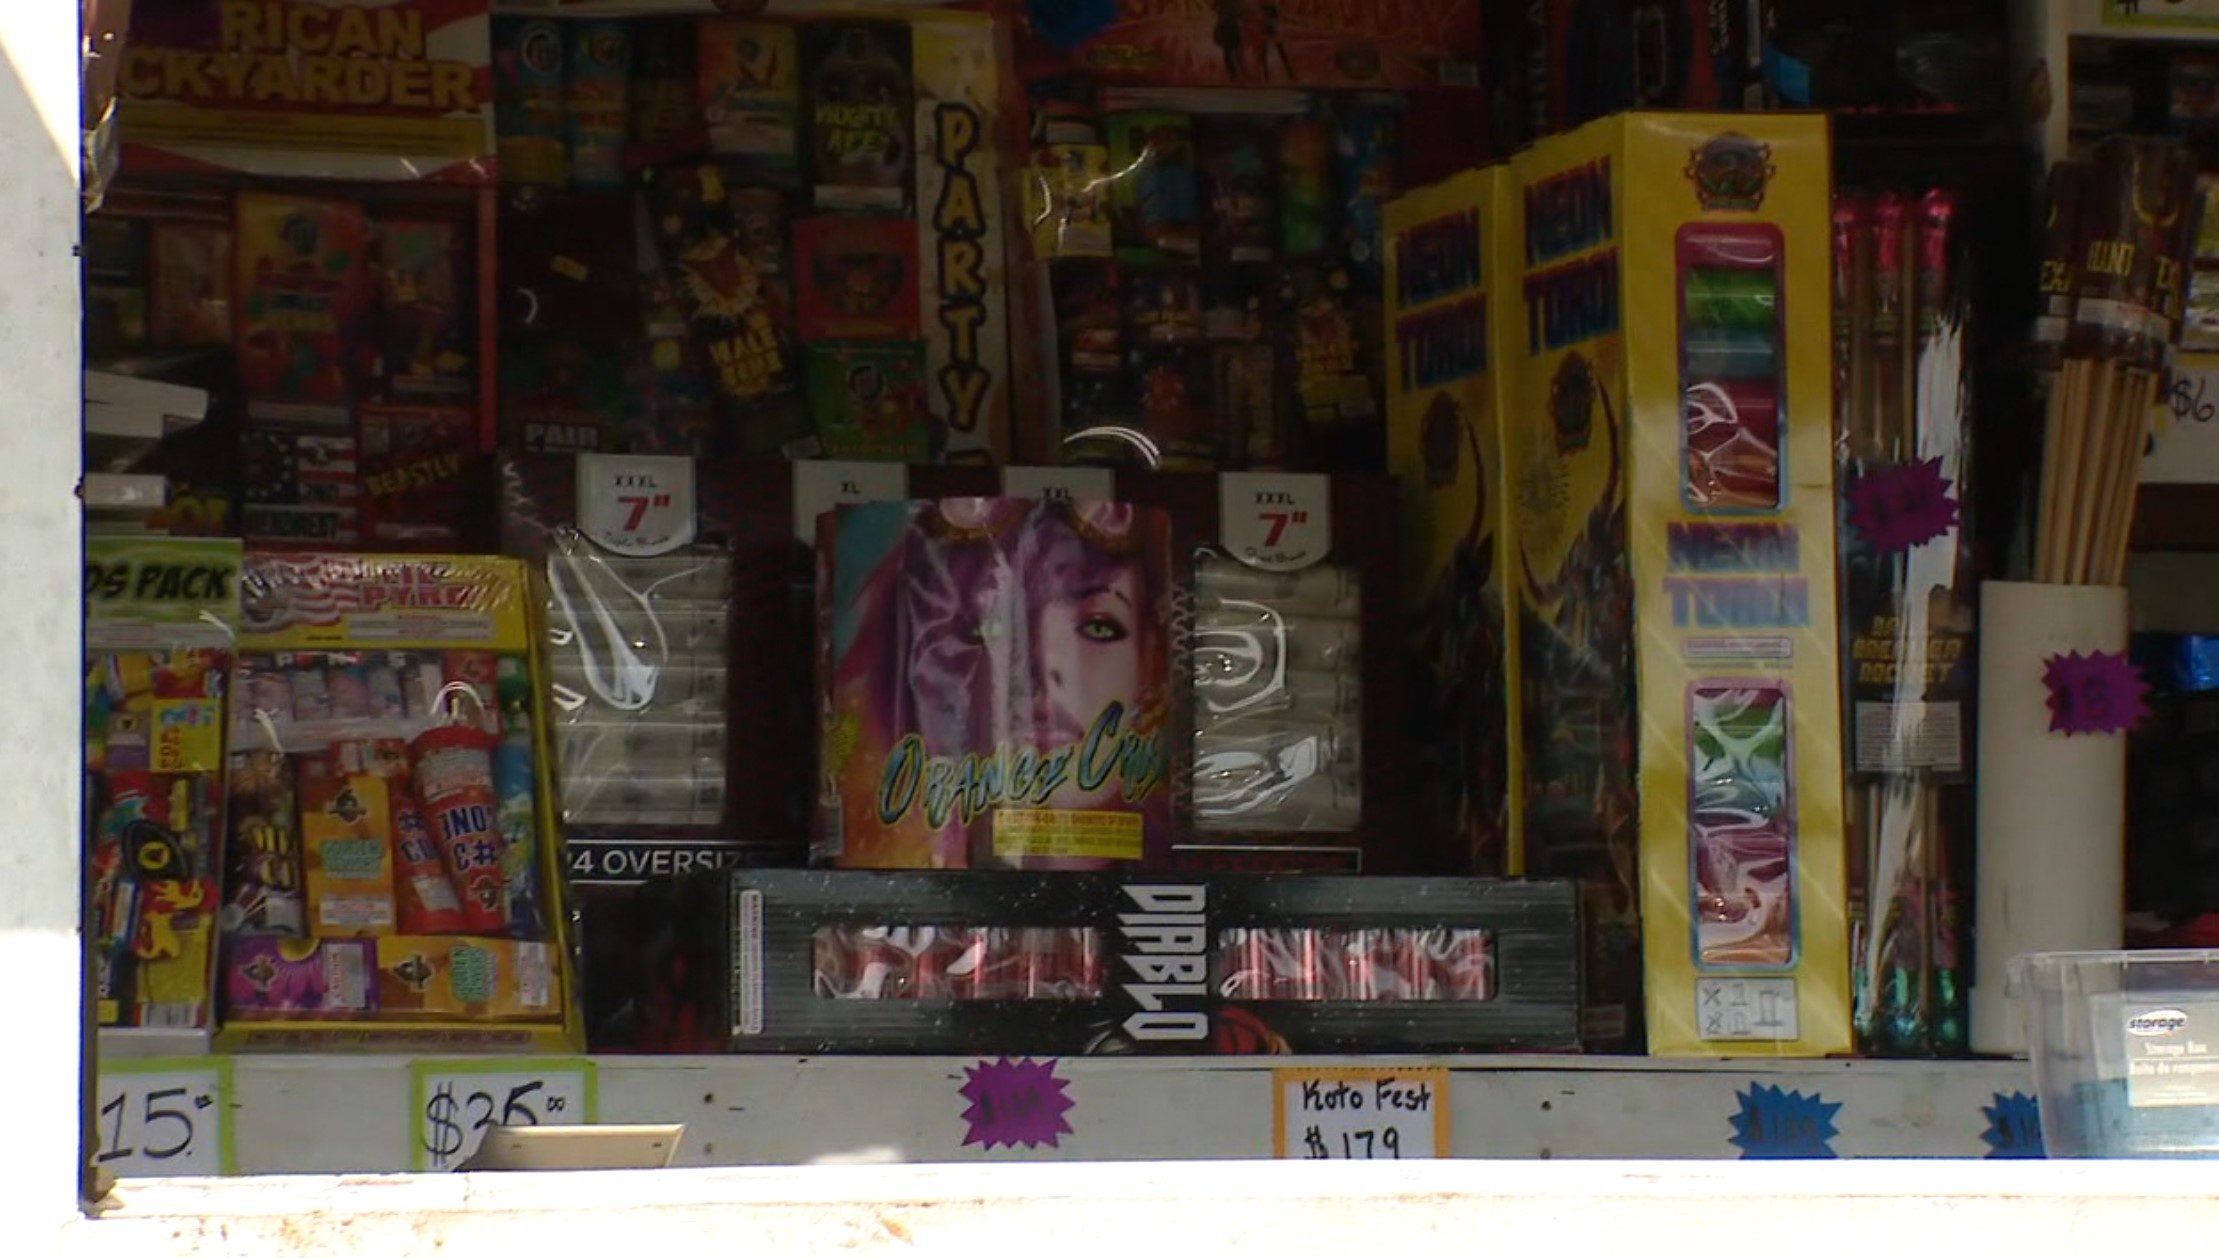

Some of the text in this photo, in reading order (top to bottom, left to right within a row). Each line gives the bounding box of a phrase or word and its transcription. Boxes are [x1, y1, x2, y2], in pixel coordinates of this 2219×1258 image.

[1522, 155, 1612, 266] NEON
[933, 102, 991, 433] PARTY
[614, 475, 658, 488] XXXL
[841, 481, 862, 494] XL
[1255, 492, 1297, 505] XXXL
[134, 564, 236, 600] PACK
[877, 732, 1075, 829] ORANGE
[566, 849, 595, 874] 4
[1116, 884, 1209, 1040] DIABLO
[2129, 1017, 2185, 1031] storage
[1302, 1076, 1432, 1111] Koto Fest
